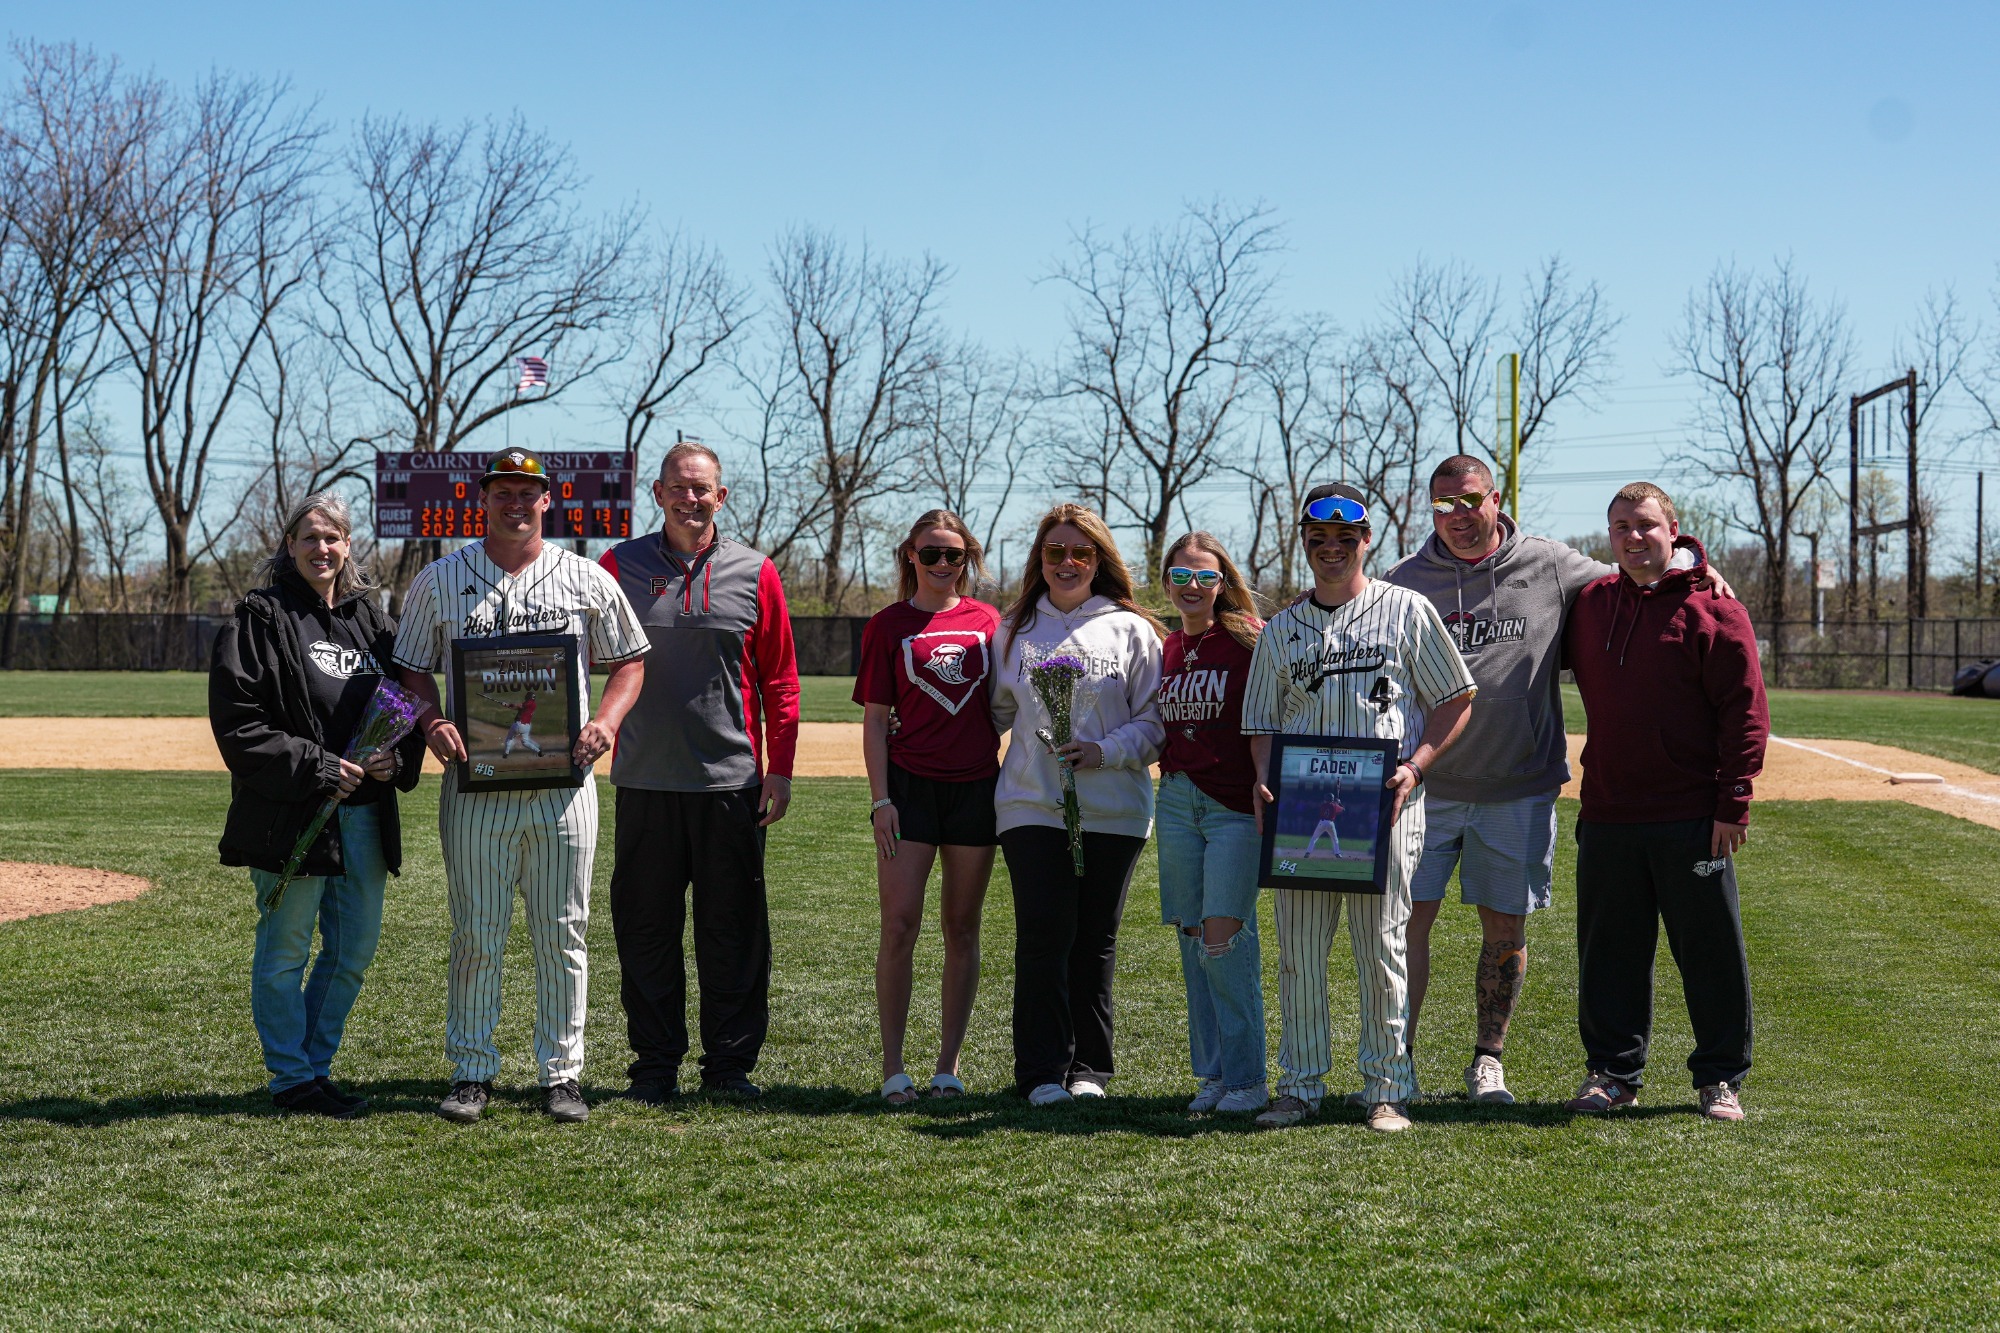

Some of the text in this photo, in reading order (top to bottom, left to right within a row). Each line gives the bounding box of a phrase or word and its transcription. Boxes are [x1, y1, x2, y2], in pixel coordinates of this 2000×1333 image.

[410, 453, 471, 469] CAIRN
[381, 473, 411, 483] AT BAT
[449, 473, 472, 483] BALL
[557, 472, 576, 483] OUT
[455, 482, 466, 499] 0
[562, 482, 573, 499] 0
[380, 509, 413, 521] GUEST
[422, 507, 431, 522] 2
[434, 507, 443, 522] 2
[446, 507, 455, 522] 0
[463, 507, 472, 522] 2
[475, 507, 484, 522] 2
[567, 508, 583, 522] 10
[596, 508, 611, 522] 13
[381, 522, 629, 537] HOME 2 0 2 0 0 4 7 3
[463, 605, 566, 638] Highlanders
[497, 659, 534, 674] ZACH
[1291, 641, 1383, 686] Highlanders
[482, 668, 556, 694] BROWN
[1158, 669, 1229, 704] CAIRN
[1368, 676, 1392, 714] 4
[474, 763, 494, 777] #16
[1310, 757, 1357, 775] CADEN
[1278, 859, 1297, 874] #4
